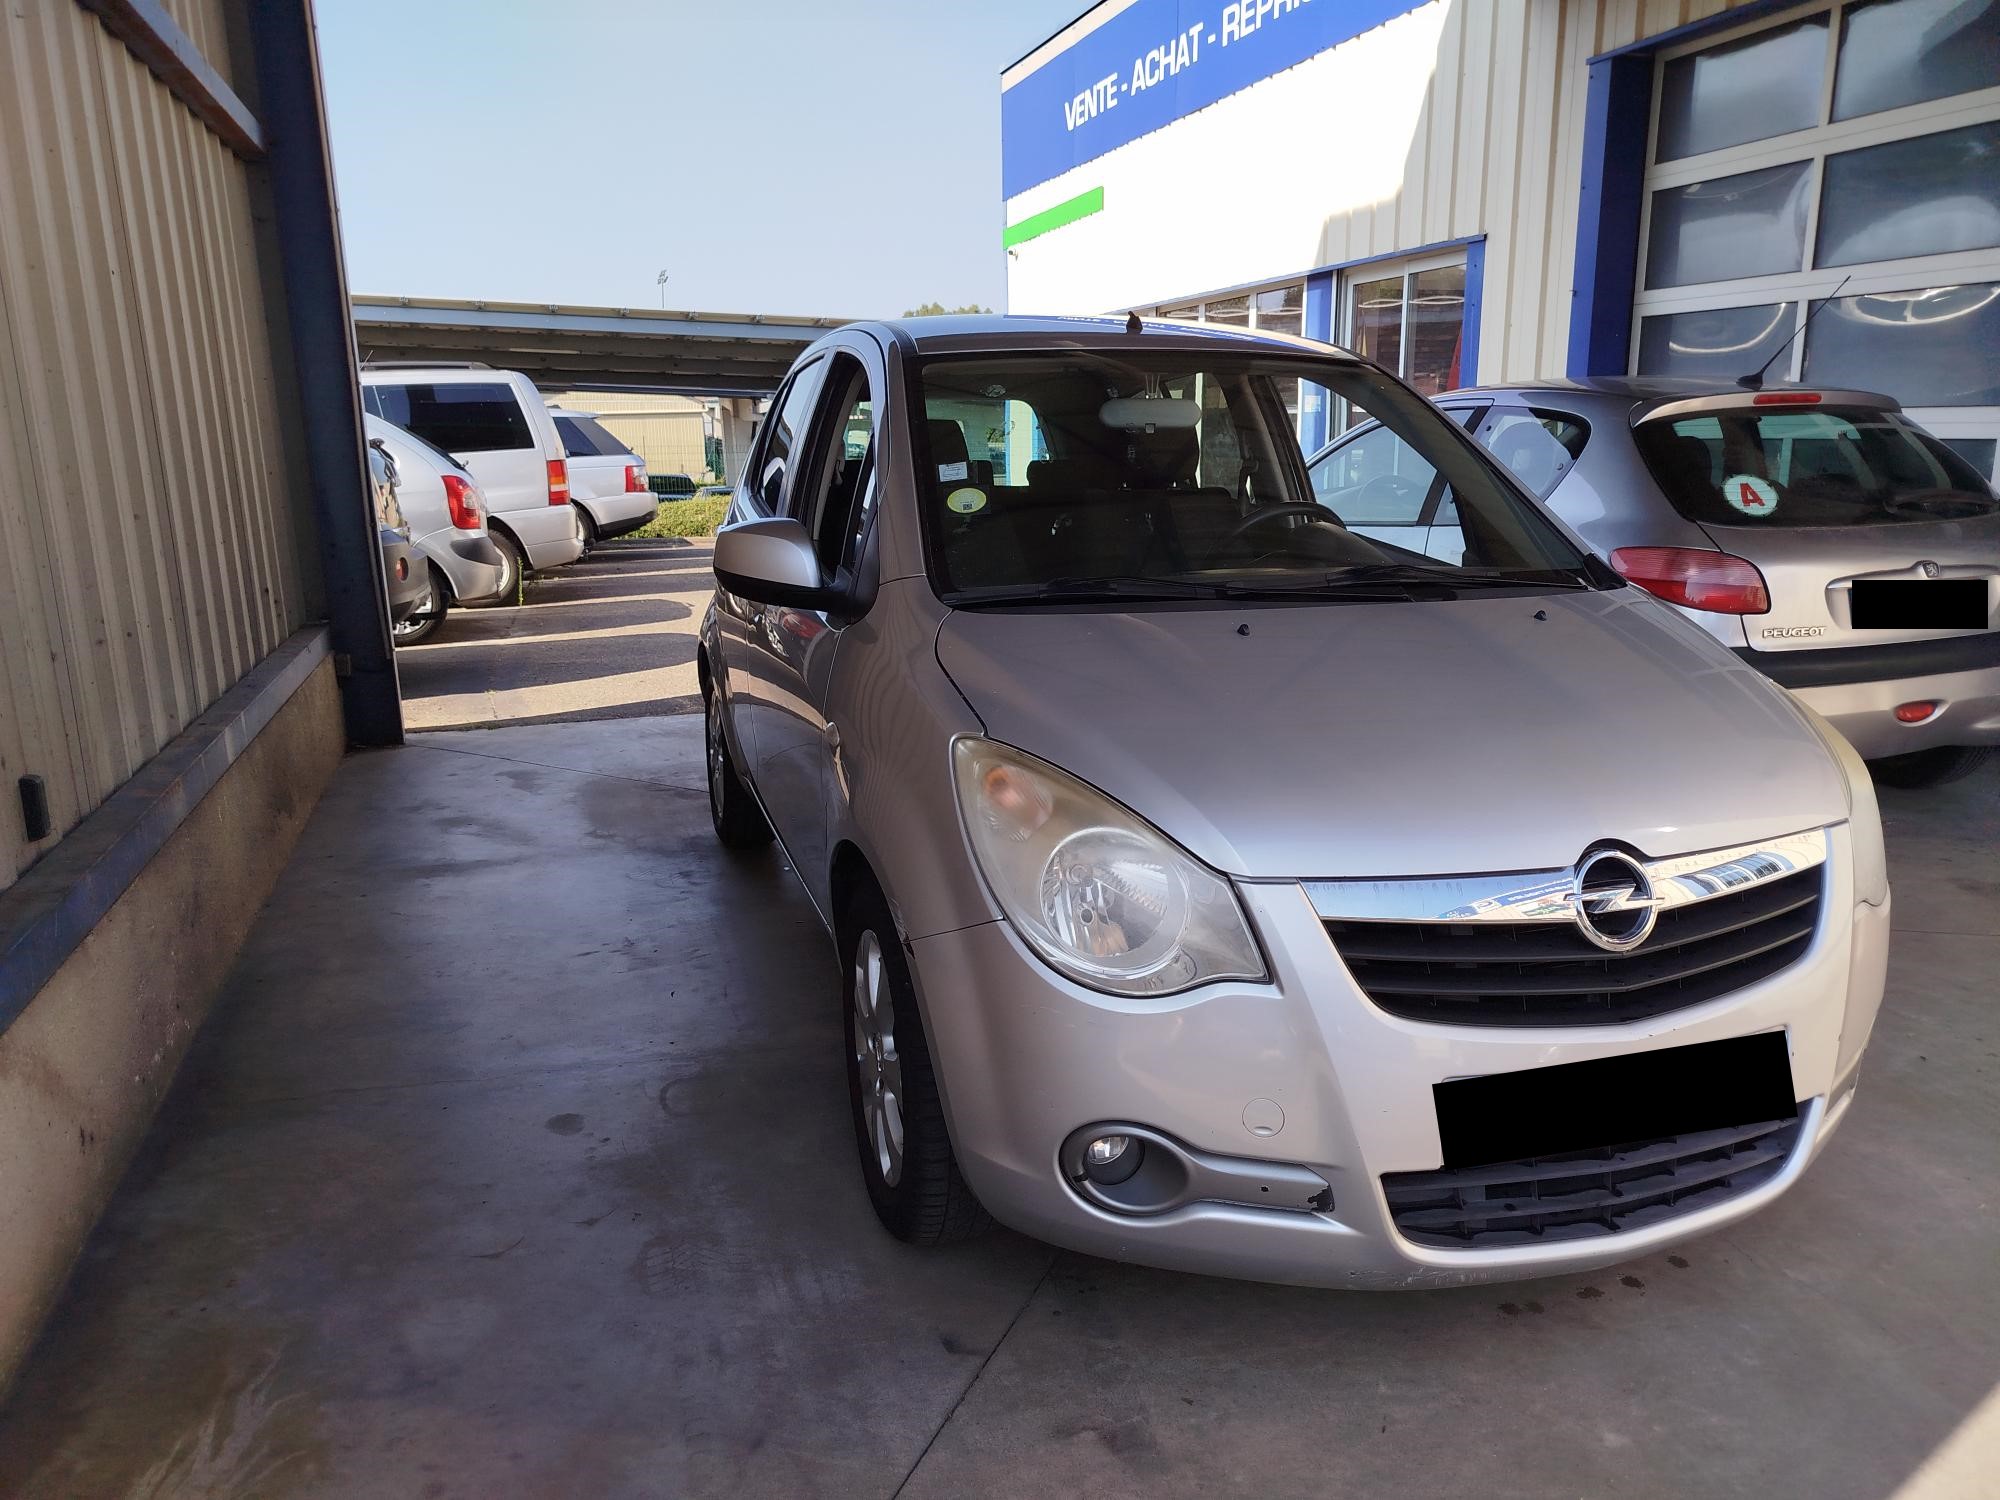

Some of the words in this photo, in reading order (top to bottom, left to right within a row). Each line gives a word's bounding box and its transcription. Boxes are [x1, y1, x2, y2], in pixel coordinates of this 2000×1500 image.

[1064, 72, 1118, 131] VENTE
[1131, 22, 1204, 96] ACHAT
[1740, 482, 1765, 507] A
[1762, 626, 1826, 638] PEUGEOT
